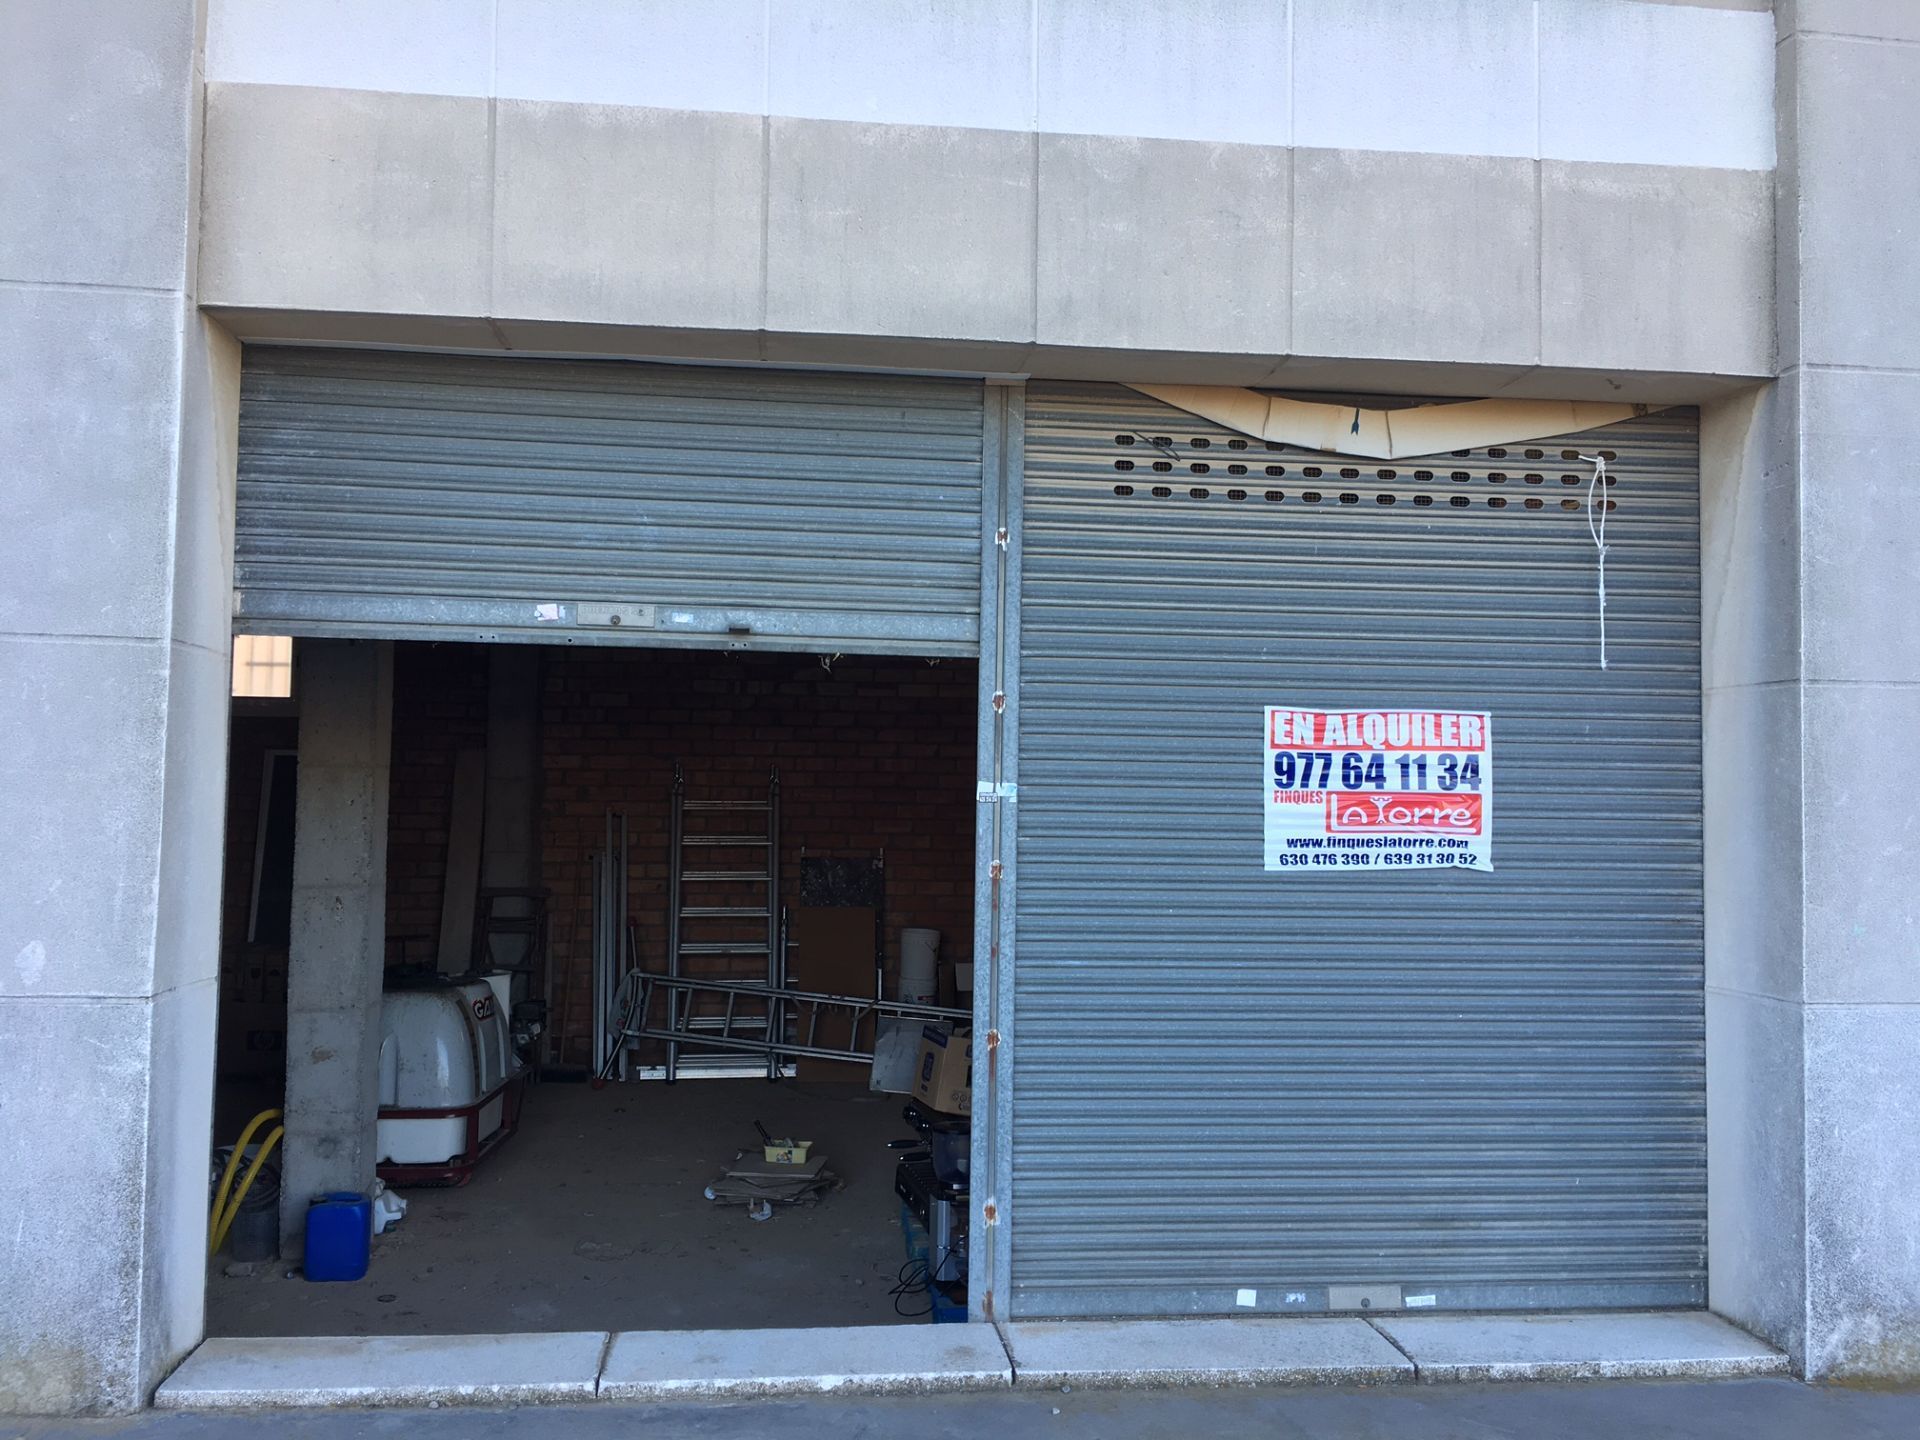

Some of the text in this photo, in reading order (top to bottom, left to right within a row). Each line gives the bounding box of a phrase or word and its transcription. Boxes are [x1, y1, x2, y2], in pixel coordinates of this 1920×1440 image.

[1274, 712, 1482, 749] EN ALQUILER
[1274, 751, 1482, 791] 977 64 11 34
[1273, 790, 1323, 805] FINQUES
[1286, 836, 1469, 850] www.finqueslatorre.com
[1279, 853, 1309, 865] 630
[1312, 853, 1338, 865] 476
[1341, 853, 1370, 865] 390
[1383, 853, 1413, 865] 639
[1416, 853, 1433, 865] 31
[1436, 853, 1455, 865] 30
[1459, 853, 1477, 865] 52
